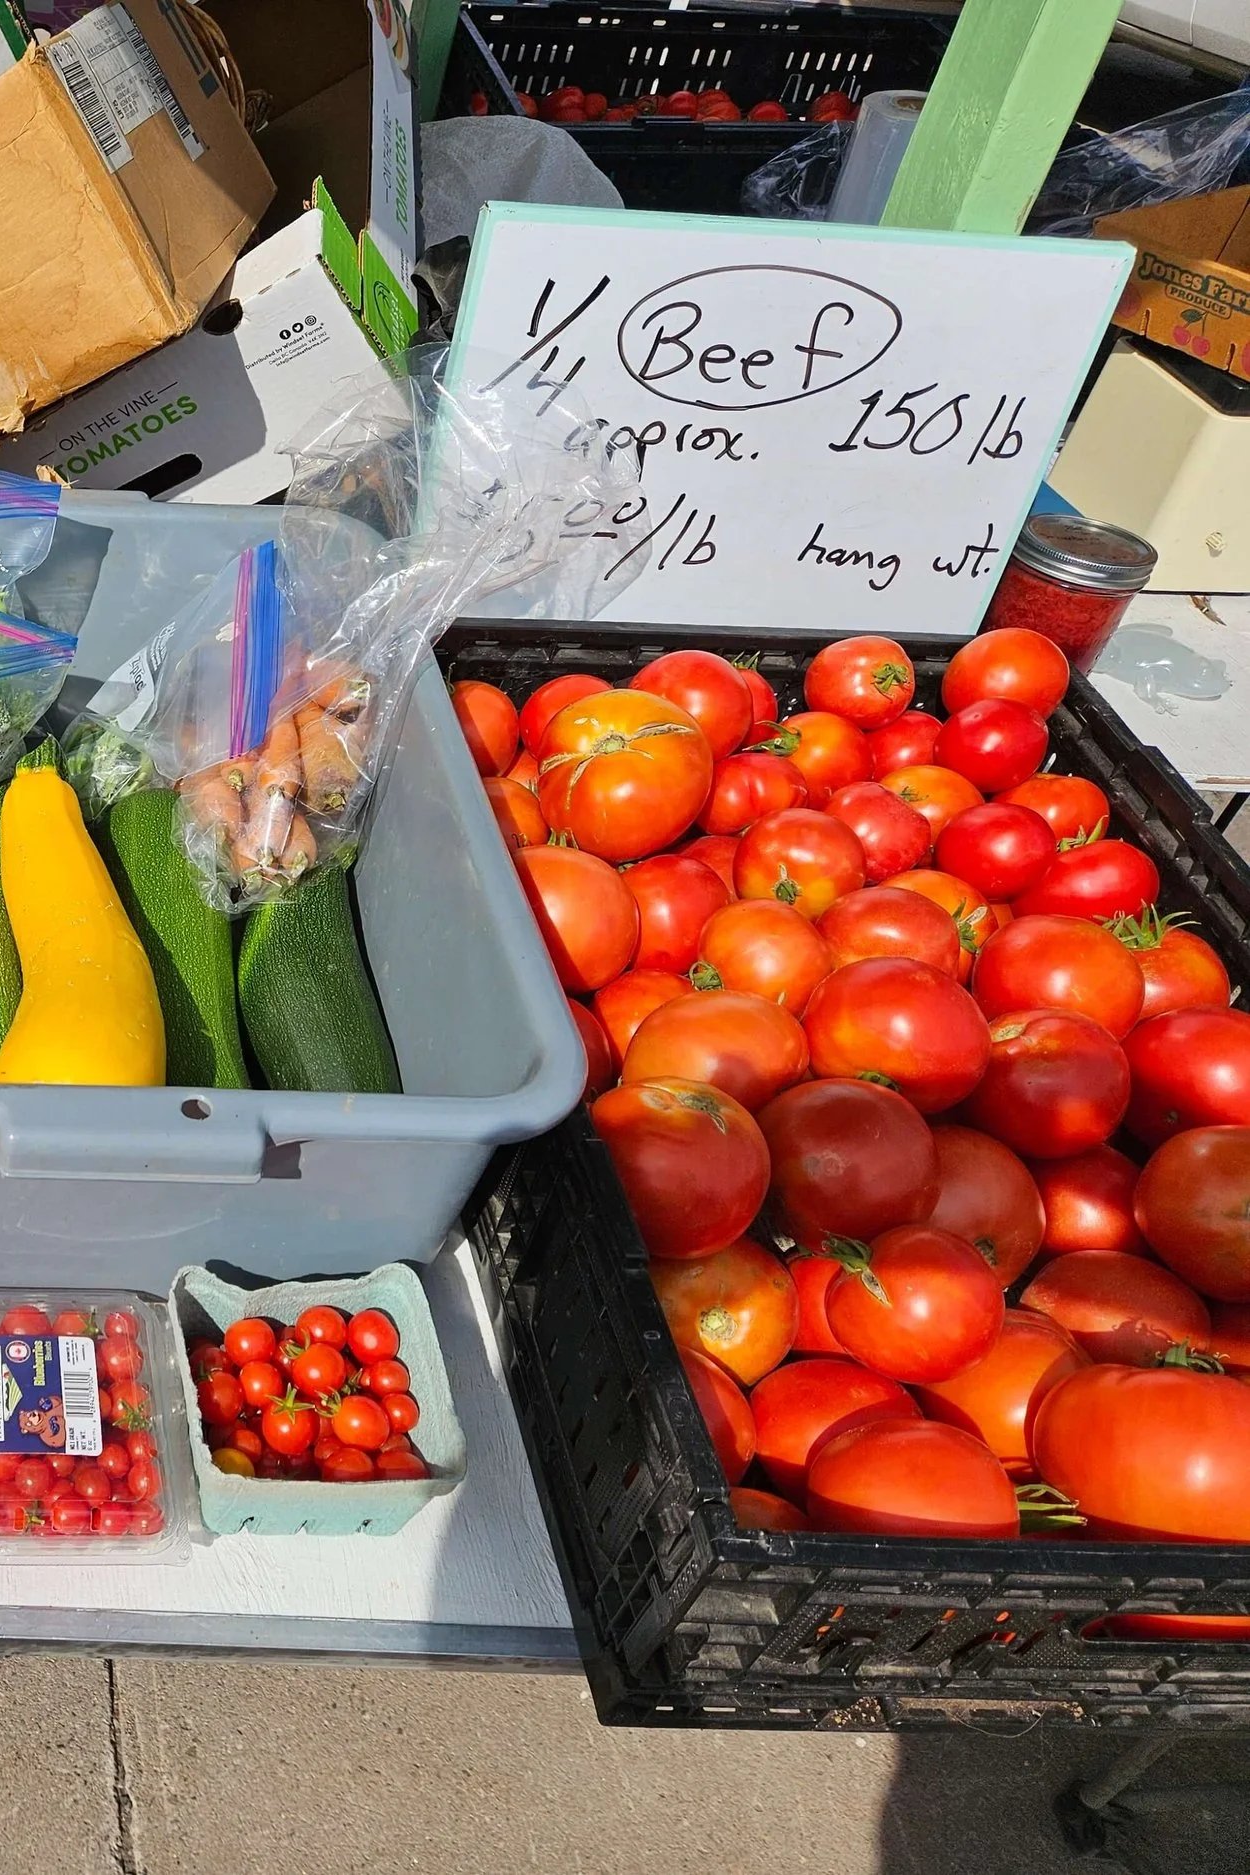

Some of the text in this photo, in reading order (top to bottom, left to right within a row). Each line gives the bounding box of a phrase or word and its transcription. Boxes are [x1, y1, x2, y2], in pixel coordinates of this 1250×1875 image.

[1138, 251, 1204, 293] Jones
[1169, 287, 1227, 316] PRODUCE
[245, 351, 276, 370] Distributed
[282, 335, 305, 350] Windset
[478, 275, 855, 417] 1/4 Beef
[54, 395, 198, 482] TOMATOES
[58, 390, 159, 451] ON THE VINE
[797, 523, 901, 592] hang
[129, 656, 145, 692] Ziploc
[32, 1340, 46, 1387] Blueberries
